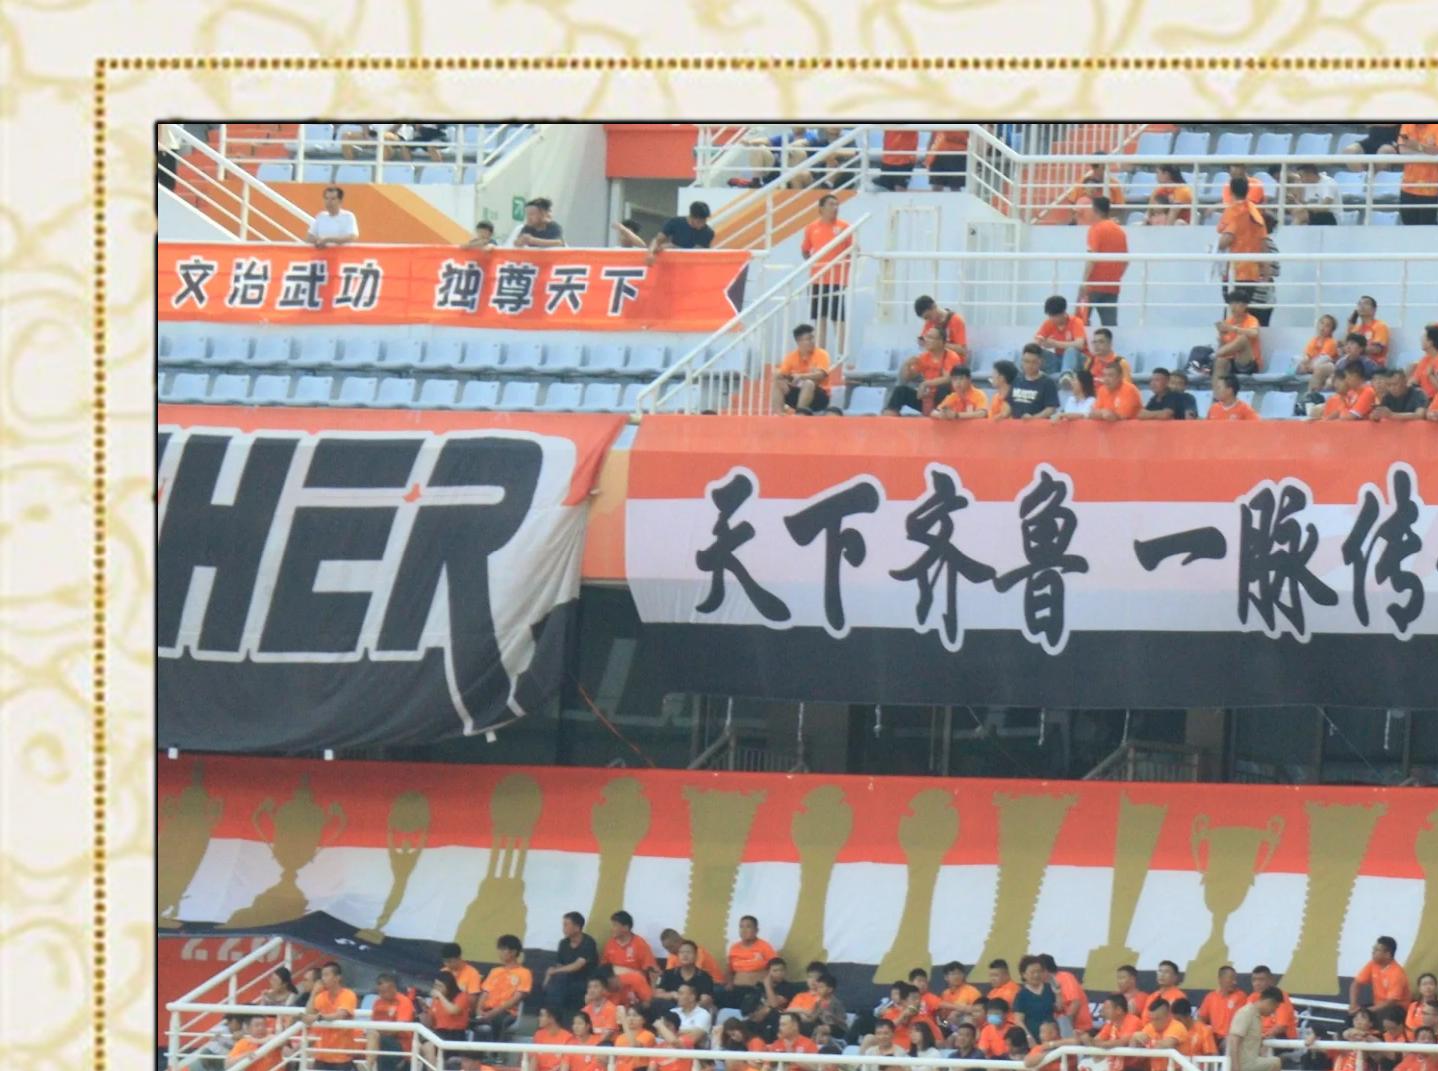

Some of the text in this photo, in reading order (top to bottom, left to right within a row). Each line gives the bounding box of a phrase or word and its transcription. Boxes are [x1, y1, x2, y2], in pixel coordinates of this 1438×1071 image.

[171, 259, 648, 316] 文治武功 独尊天下
[158, 430, 545, 735] HER
[692, 462, 1092, 655] 天下齐鲁
